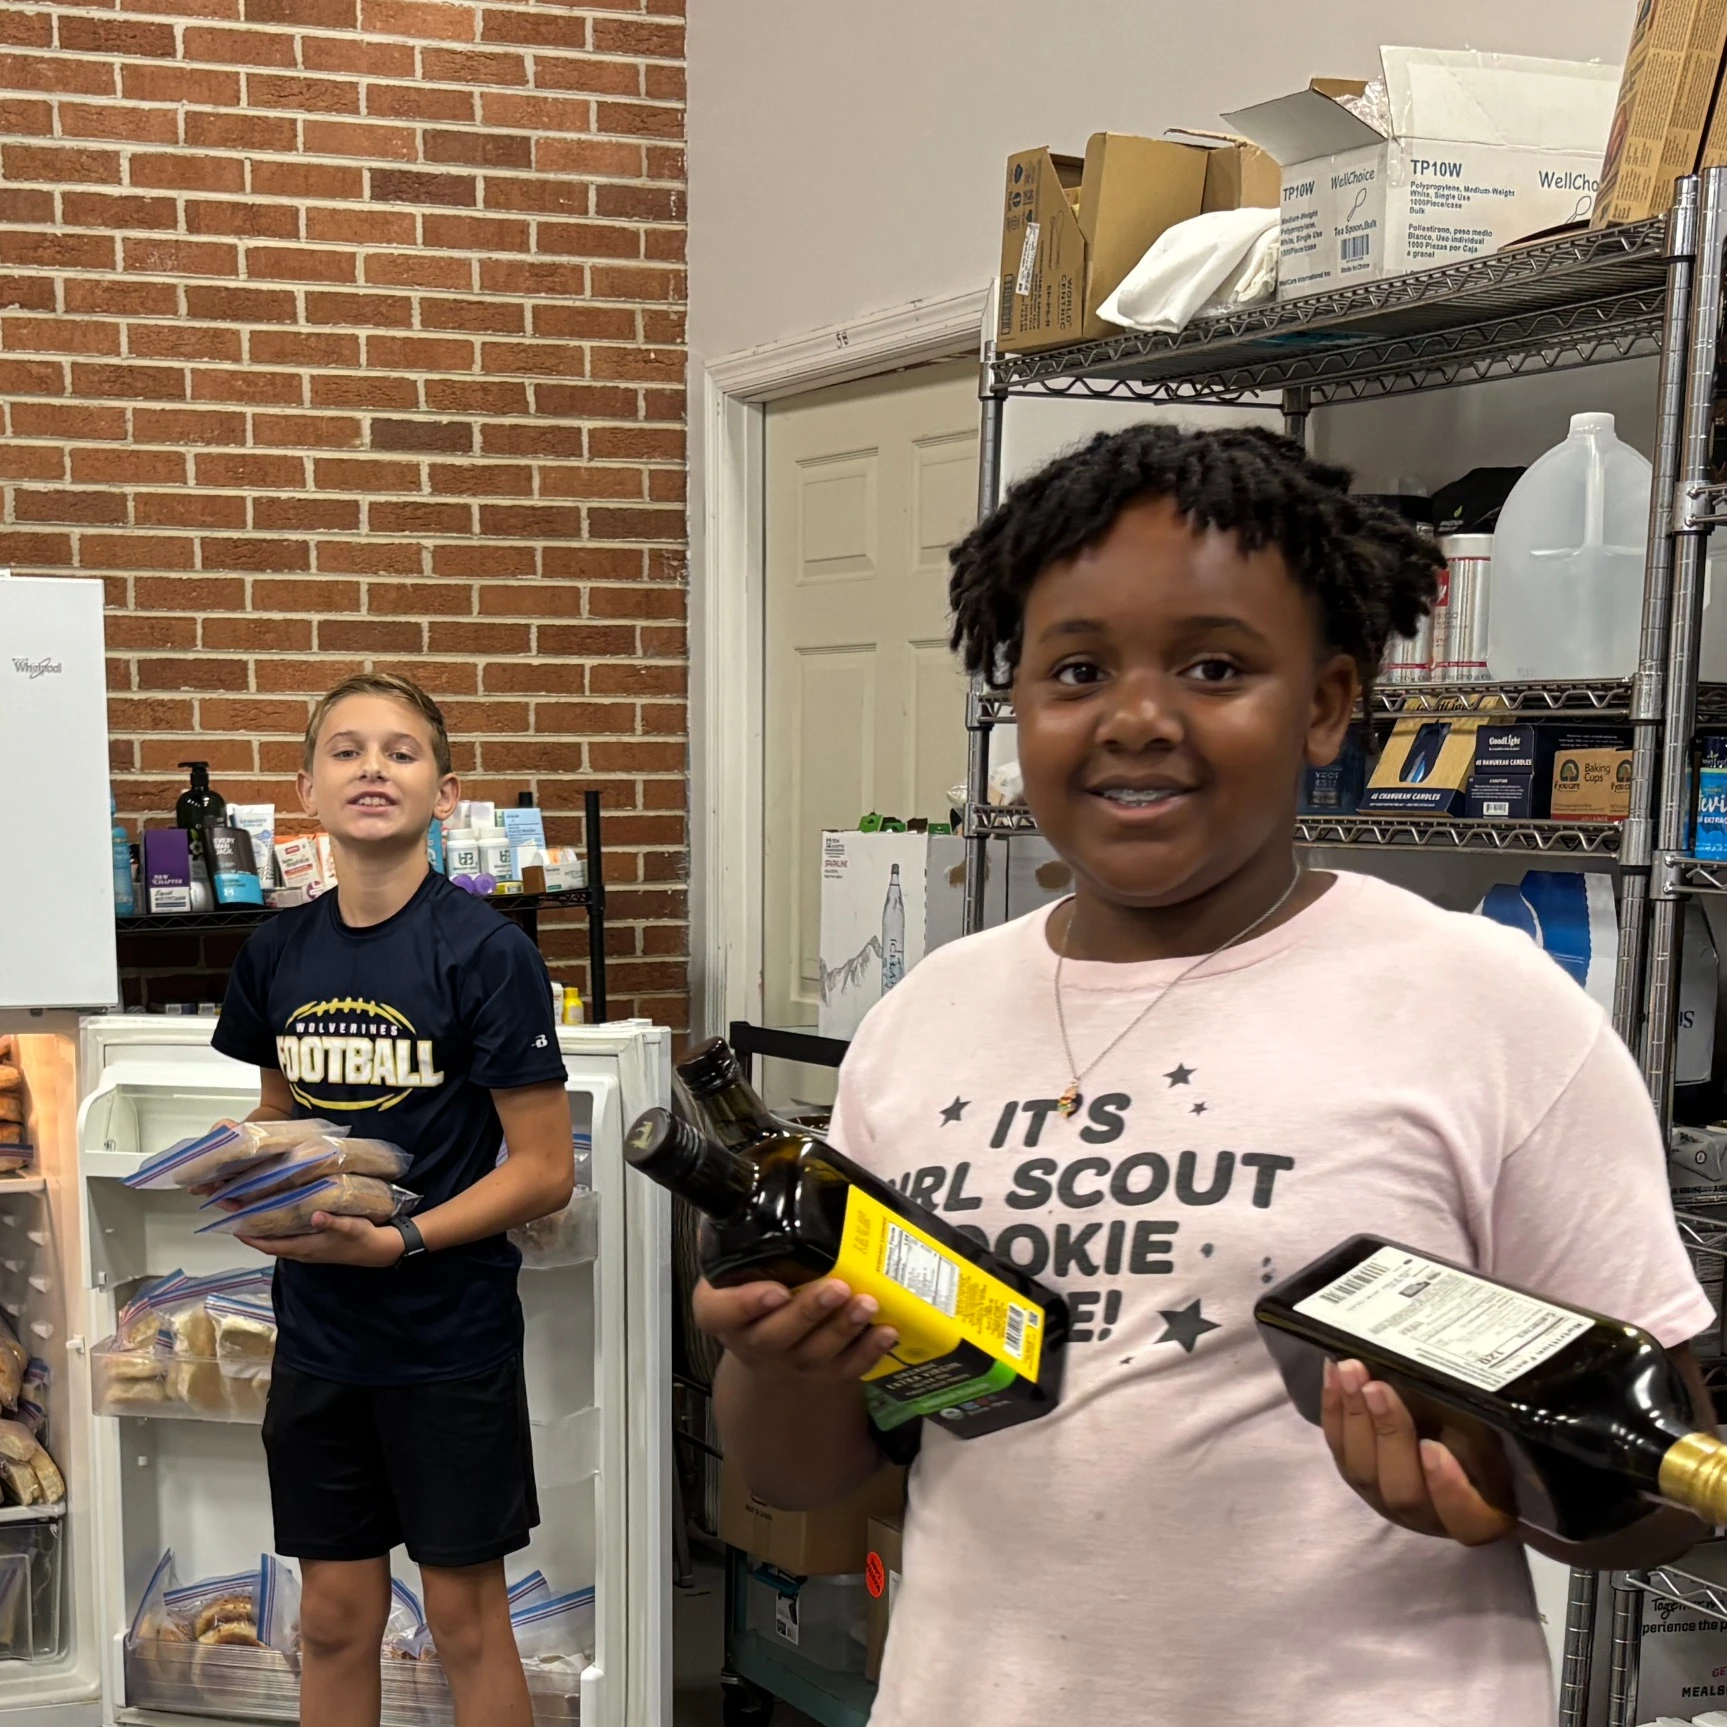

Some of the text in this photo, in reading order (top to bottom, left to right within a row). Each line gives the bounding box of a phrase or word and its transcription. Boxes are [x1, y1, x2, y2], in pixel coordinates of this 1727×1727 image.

[1410, 159, 1462, 178] TP10W
[1331, 169, 1375, 190] WellChoice
[1283, 180, 1316, 201] TP10W
[1410, 190, 1471, 202] White, Single Use
[1409, 206, 1426, 215] Bulk
[1334, 226, 1344, 237] Tea
[1453, 228, 1471, 237] peso
[1472, 228, 1493, 237] medio
[1408, 231, 1485, 245] Blanco, Uso individual
[1408, 241, 1424, 249] 1000
[1425, 241, 1448, 251] Piezas
[1449, 244, 1461, 253] por
[12, 657, 62, 680] Whirlpool
[1489, 734, 1521, 747] GoodLight
[1584, 763, 1611, 775] Baking
[1584, 773, 1604, 784] Cups
[1412, 792, 1441, 801] CANDLES
[213, 837, 235, 845] EVERY
[296, 1022, 399, 1037] WOLVERINES
[275, 1035, 445, 1088] FOOTBALL
[1004, 1149, 1295, 1210] SCOUT
[1698, 1619, 1718, 1631] the
